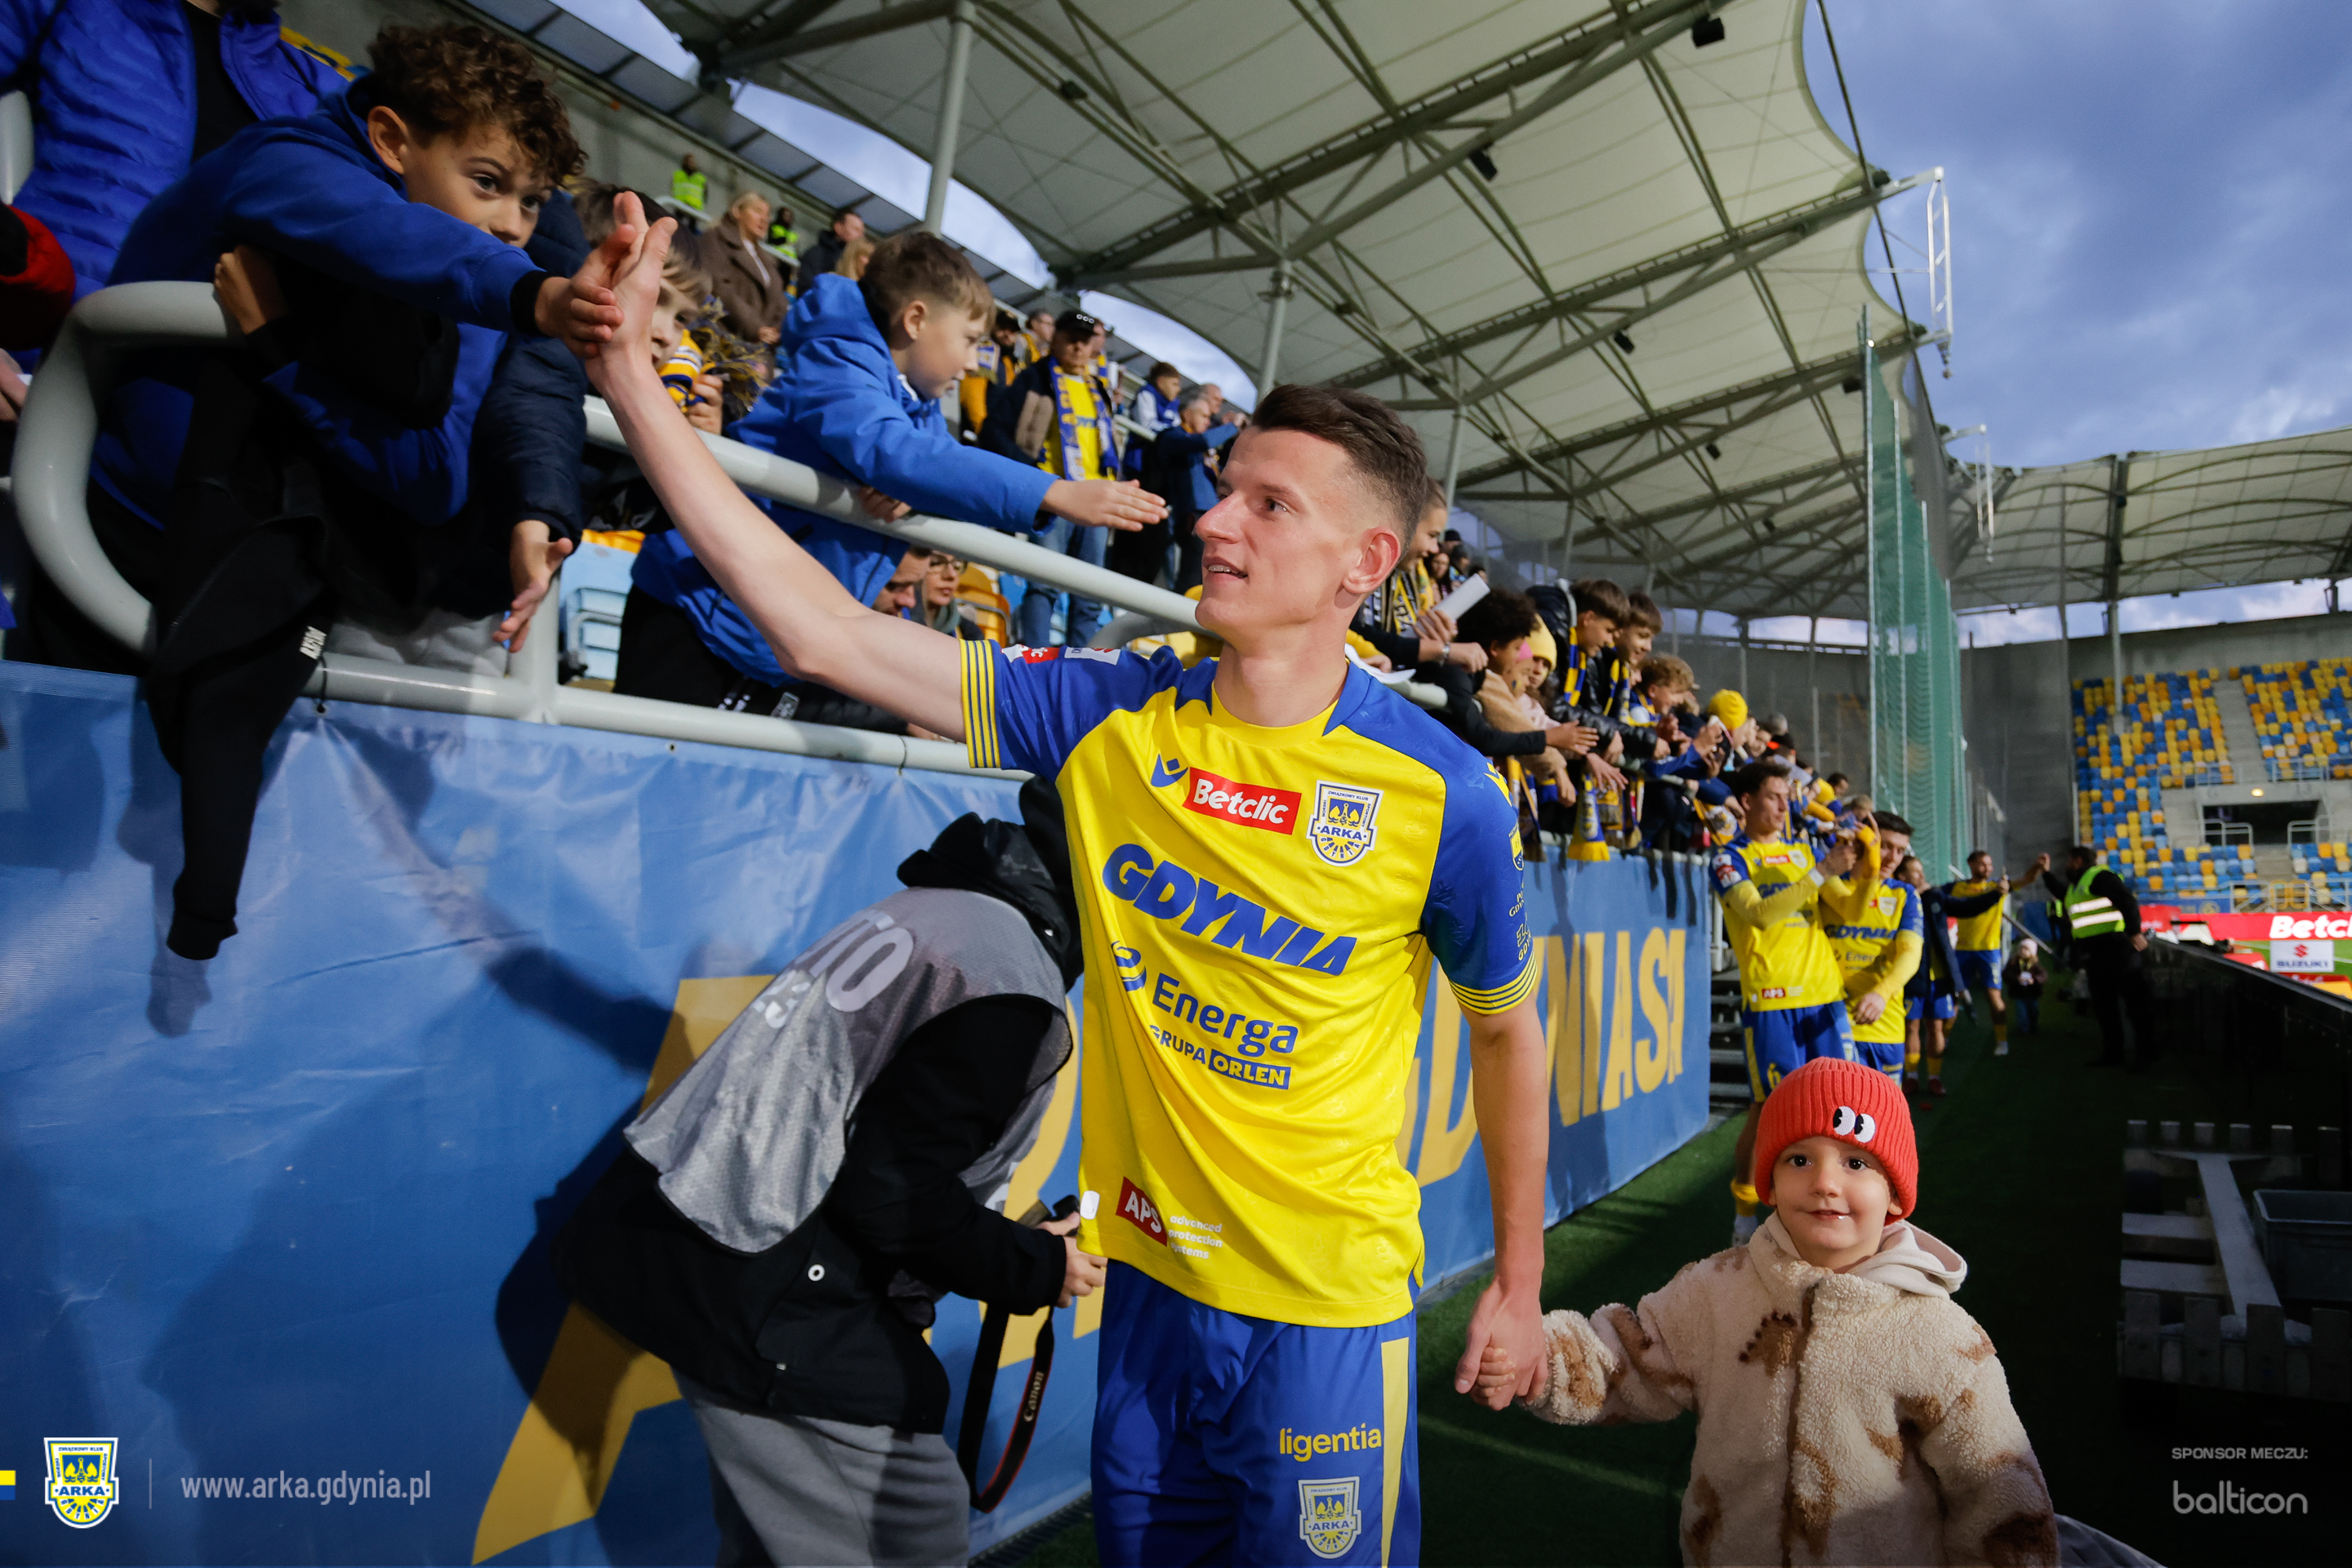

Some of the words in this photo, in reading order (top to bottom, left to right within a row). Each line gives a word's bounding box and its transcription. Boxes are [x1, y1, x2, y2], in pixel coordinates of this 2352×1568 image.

[1193, 778, 1290, 824] Betclic
[1328, 791, 1356, 799] ZWIĄZKOWY
[1320, 825, 1363, 841] ARKA
[1102, 843, 1357, 977] GDYNIA
[1152, 973, 1298, 1058] Energa
[1150, 1024, 1206, 1065] GRUPA
[1212, 1054, 1286, 1086] ORLEN
[1125, 1190, 1162, 1233] APS
[1169, 1214, 1223, 1233] advanced
[1168, 1228, 1223, 1249] protection
[1022, 1370, 1045, 1423] Canon
[1279, 1423, 1382, 1463] ligentia
[1312, 1520, 1350, 1531] ARKA
